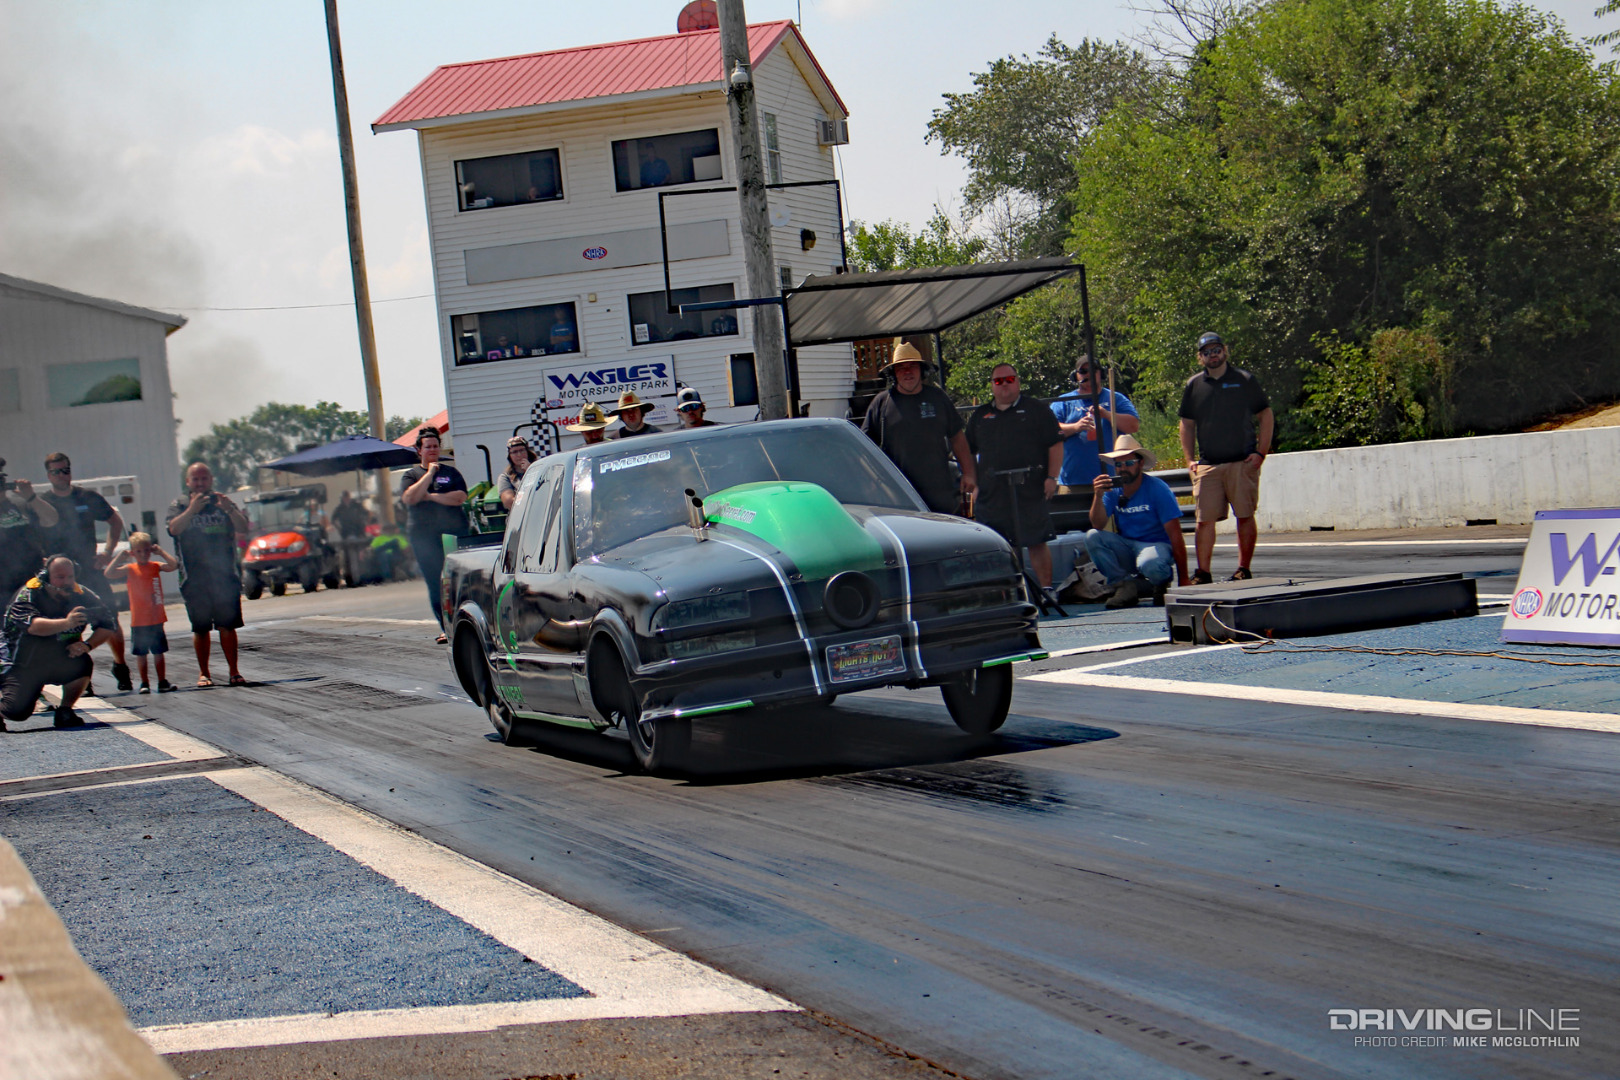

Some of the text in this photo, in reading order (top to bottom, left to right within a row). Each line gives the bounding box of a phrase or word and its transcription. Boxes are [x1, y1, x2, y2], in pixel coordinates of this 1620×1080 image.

[585, 248, 606, 259] NHRA
[547, 362, 669, 390] WAGLER
[559, 379, 669, 399] MOTORSPORTS PARK
[1514, 591, 1540, 616] NHRA
